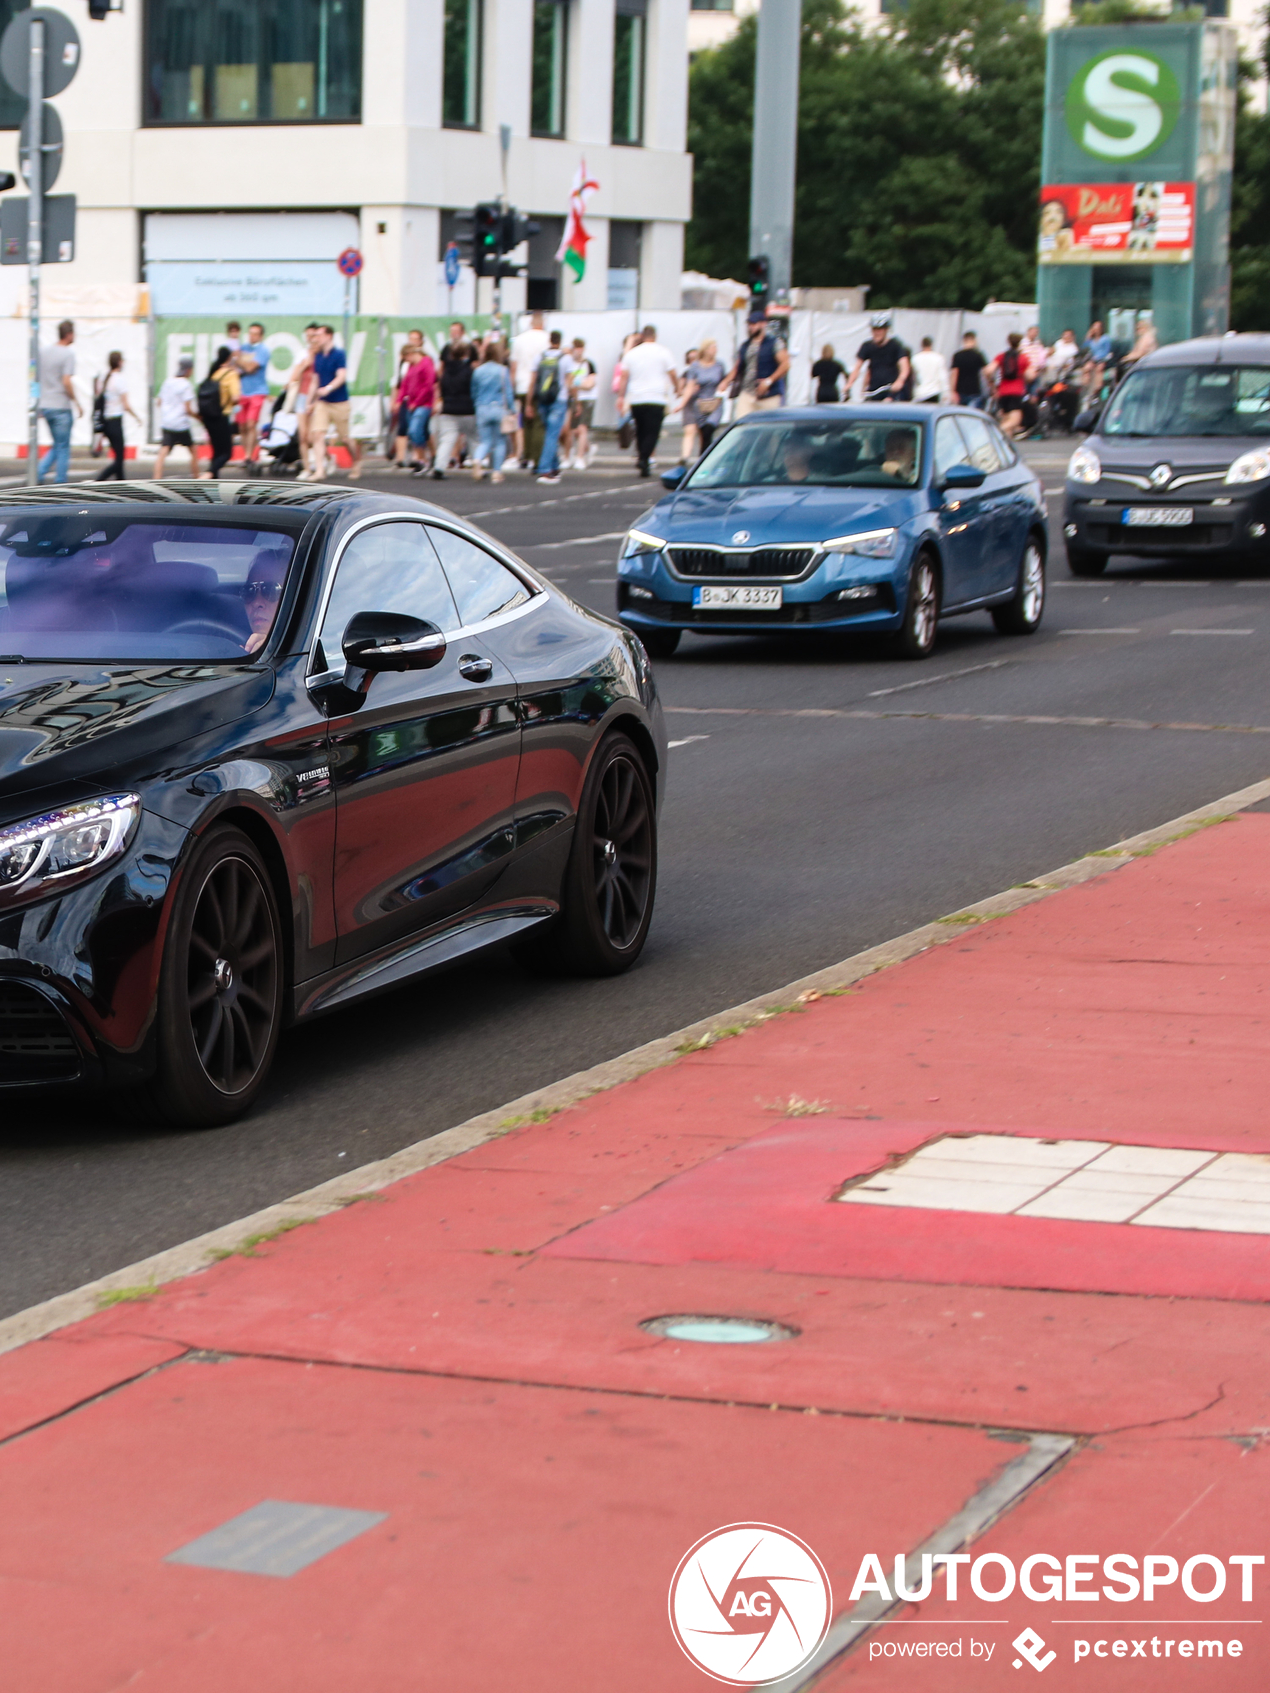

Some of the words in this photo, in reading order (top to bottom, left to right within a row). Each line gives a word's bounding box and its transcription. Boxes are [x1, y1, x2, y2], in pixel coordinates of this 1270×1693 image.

[1084, 54, 1162, 157] S
[702, 587, 711, 603] B
[722, 588, 739, 603] JK
[743, 588, 779, 604] 3337
